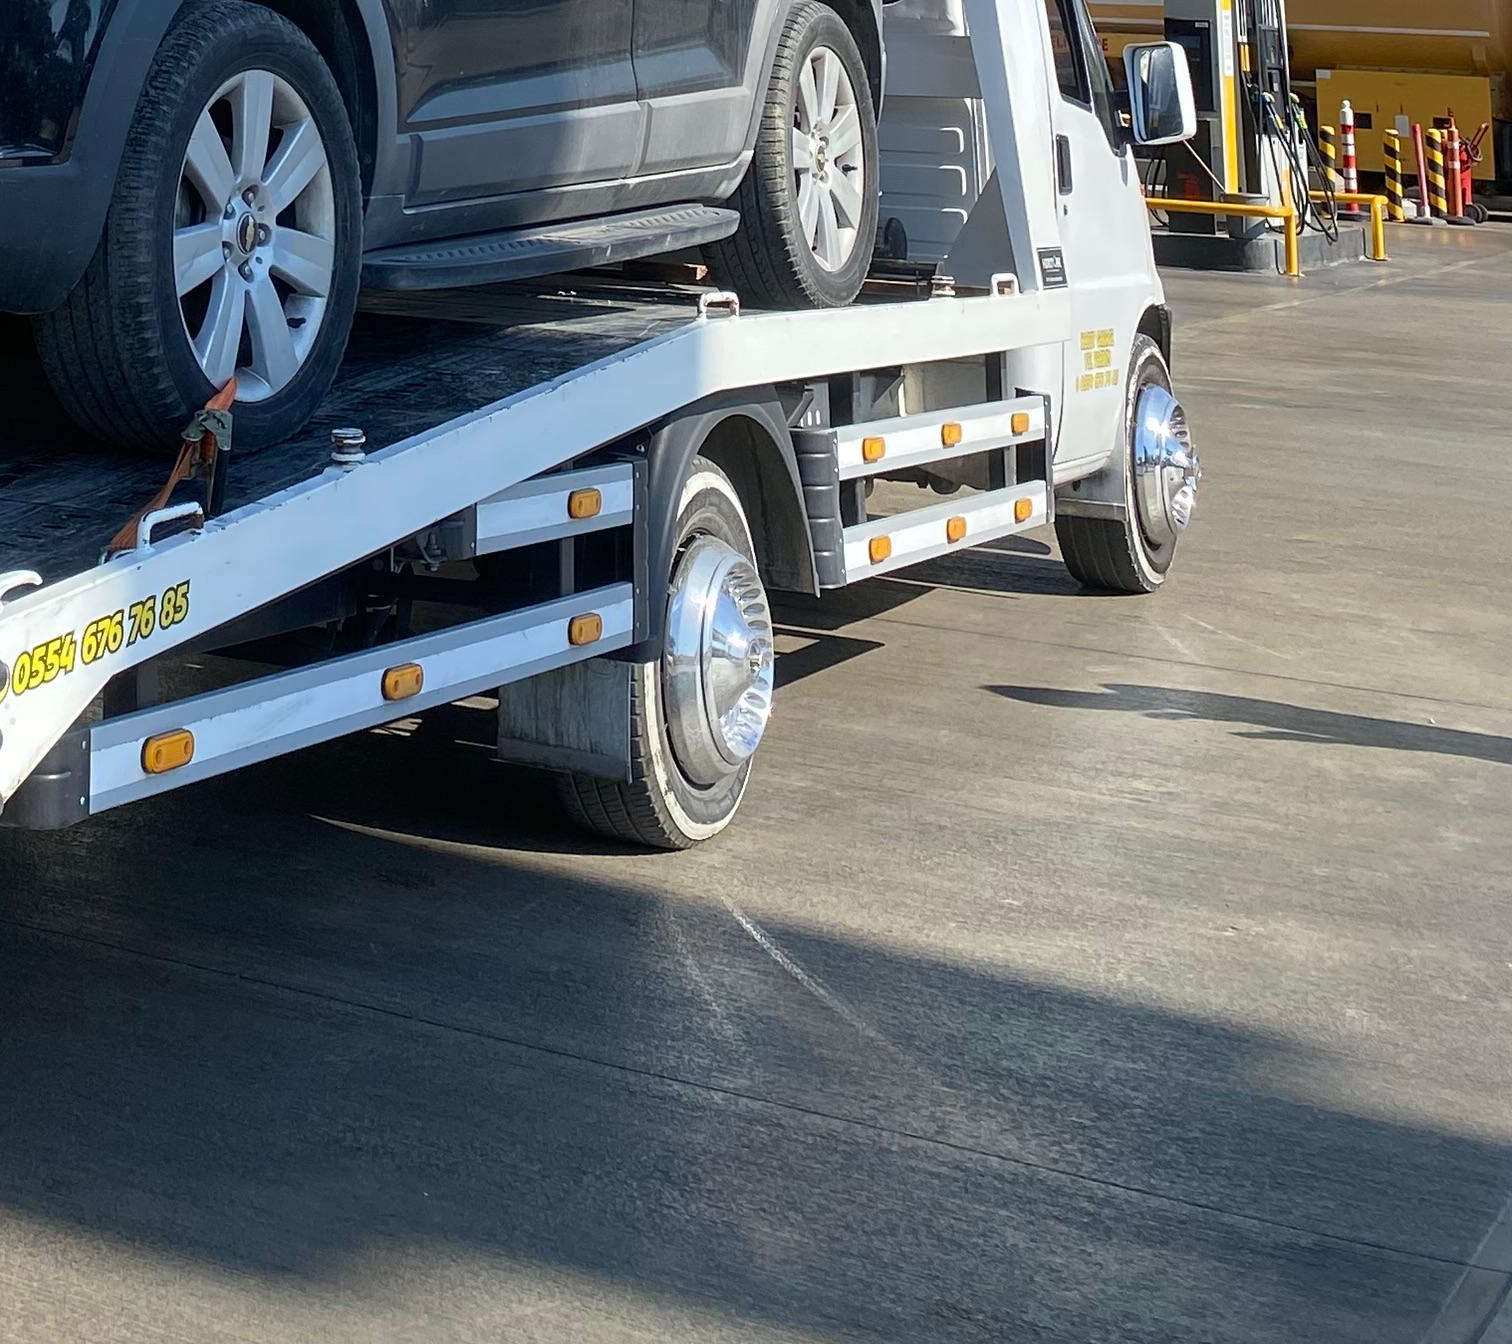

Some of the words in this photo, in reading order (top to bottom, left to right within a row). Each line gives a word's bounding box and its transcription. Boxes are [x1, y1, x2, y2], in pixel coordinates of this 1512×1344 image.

[11, 630, 78, 695] 0554
[81, 610, 124, 665] 676
[125, 595, 157, 648] 76
[158, 579, 191, 630] 85
